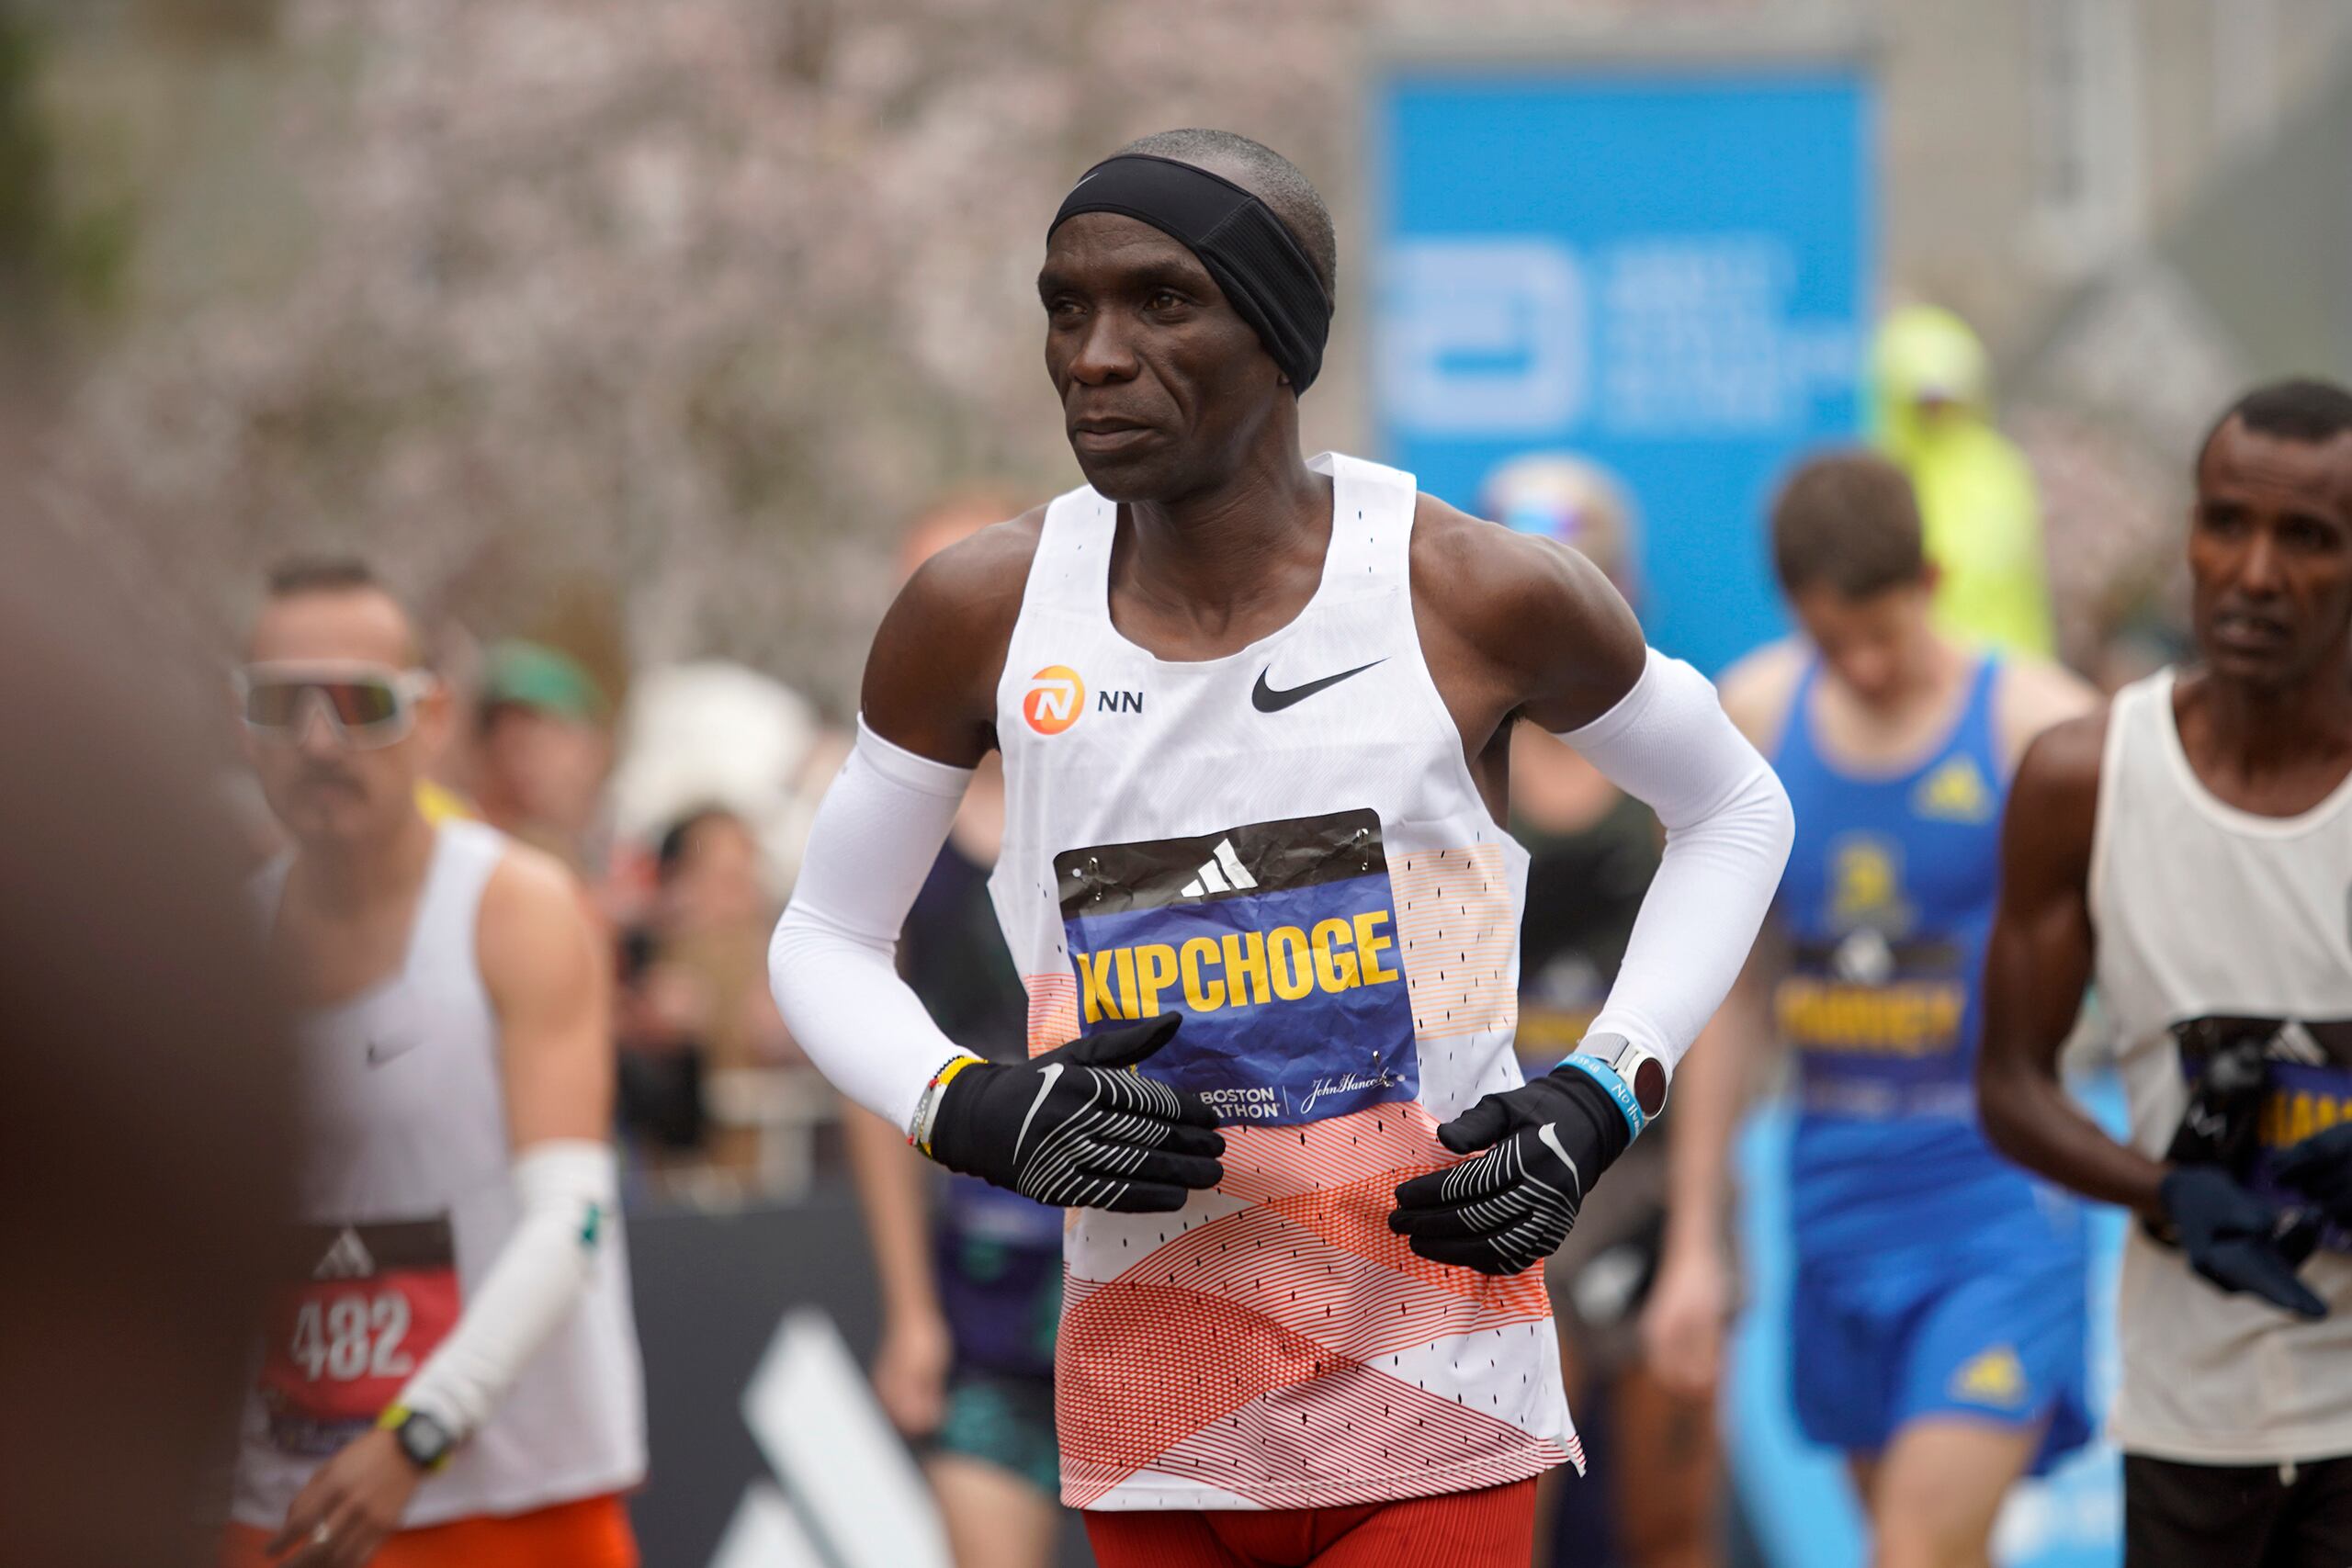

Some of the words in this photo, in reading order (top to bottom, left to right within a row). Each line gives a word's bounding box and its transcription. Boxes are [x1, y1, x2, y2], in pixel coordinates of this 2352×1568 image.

[1098, 691, 1144, 714] NN
[1077, 910, 1398, 1025] KIPCHOGE
[1200, 1087, 1274, 1105] BOSTON
[1300, 1077, 1338, 1114] John
[291, 1291, 413, 1381] 482
